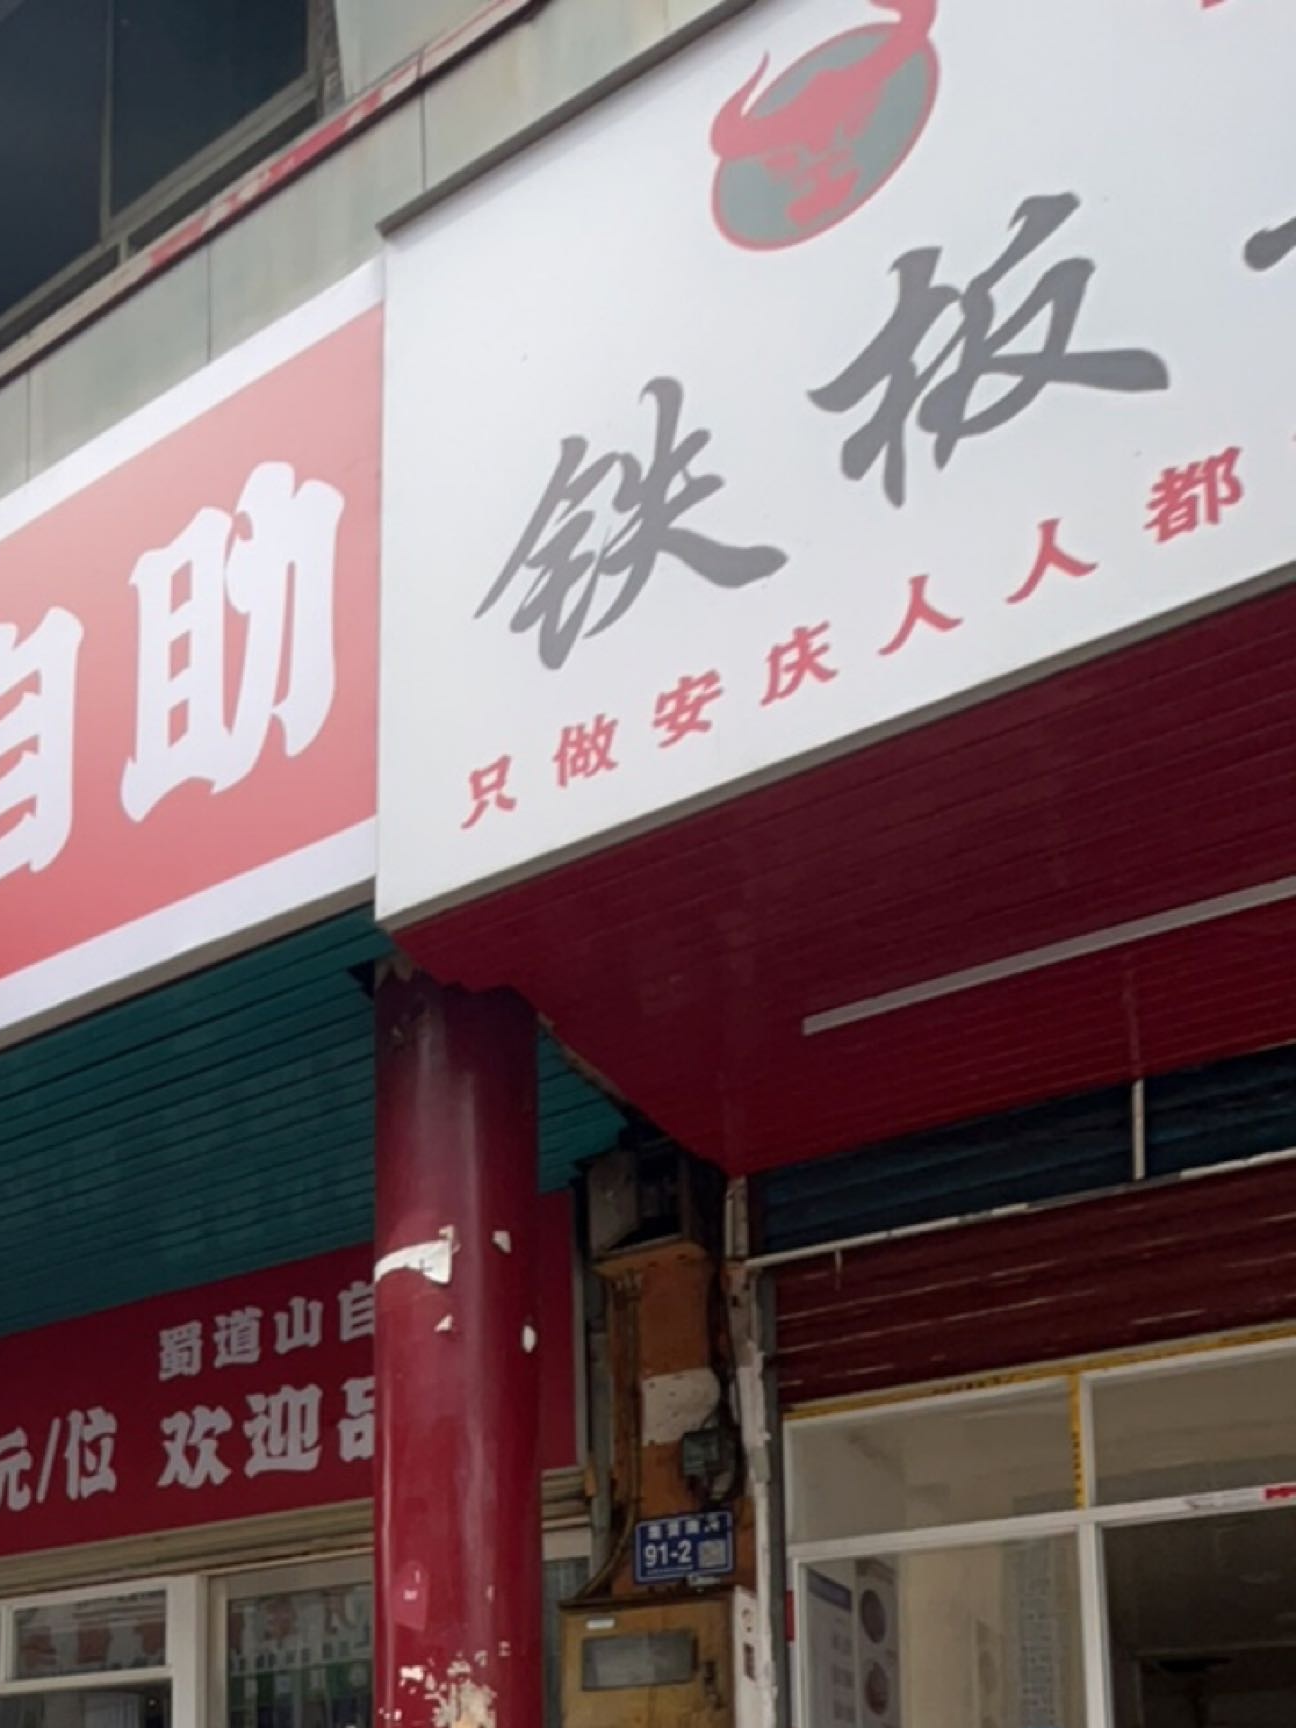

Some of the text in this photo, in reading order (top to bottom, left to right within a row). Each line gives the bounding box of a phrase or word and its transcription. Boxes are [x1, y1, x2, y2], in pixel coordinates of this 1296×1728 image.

[474, 192, 1296, 670] 铁板
[461, 446, 1245, 830] 只做安庆人人都
[644, 1539, 693, 1570] 91-2
